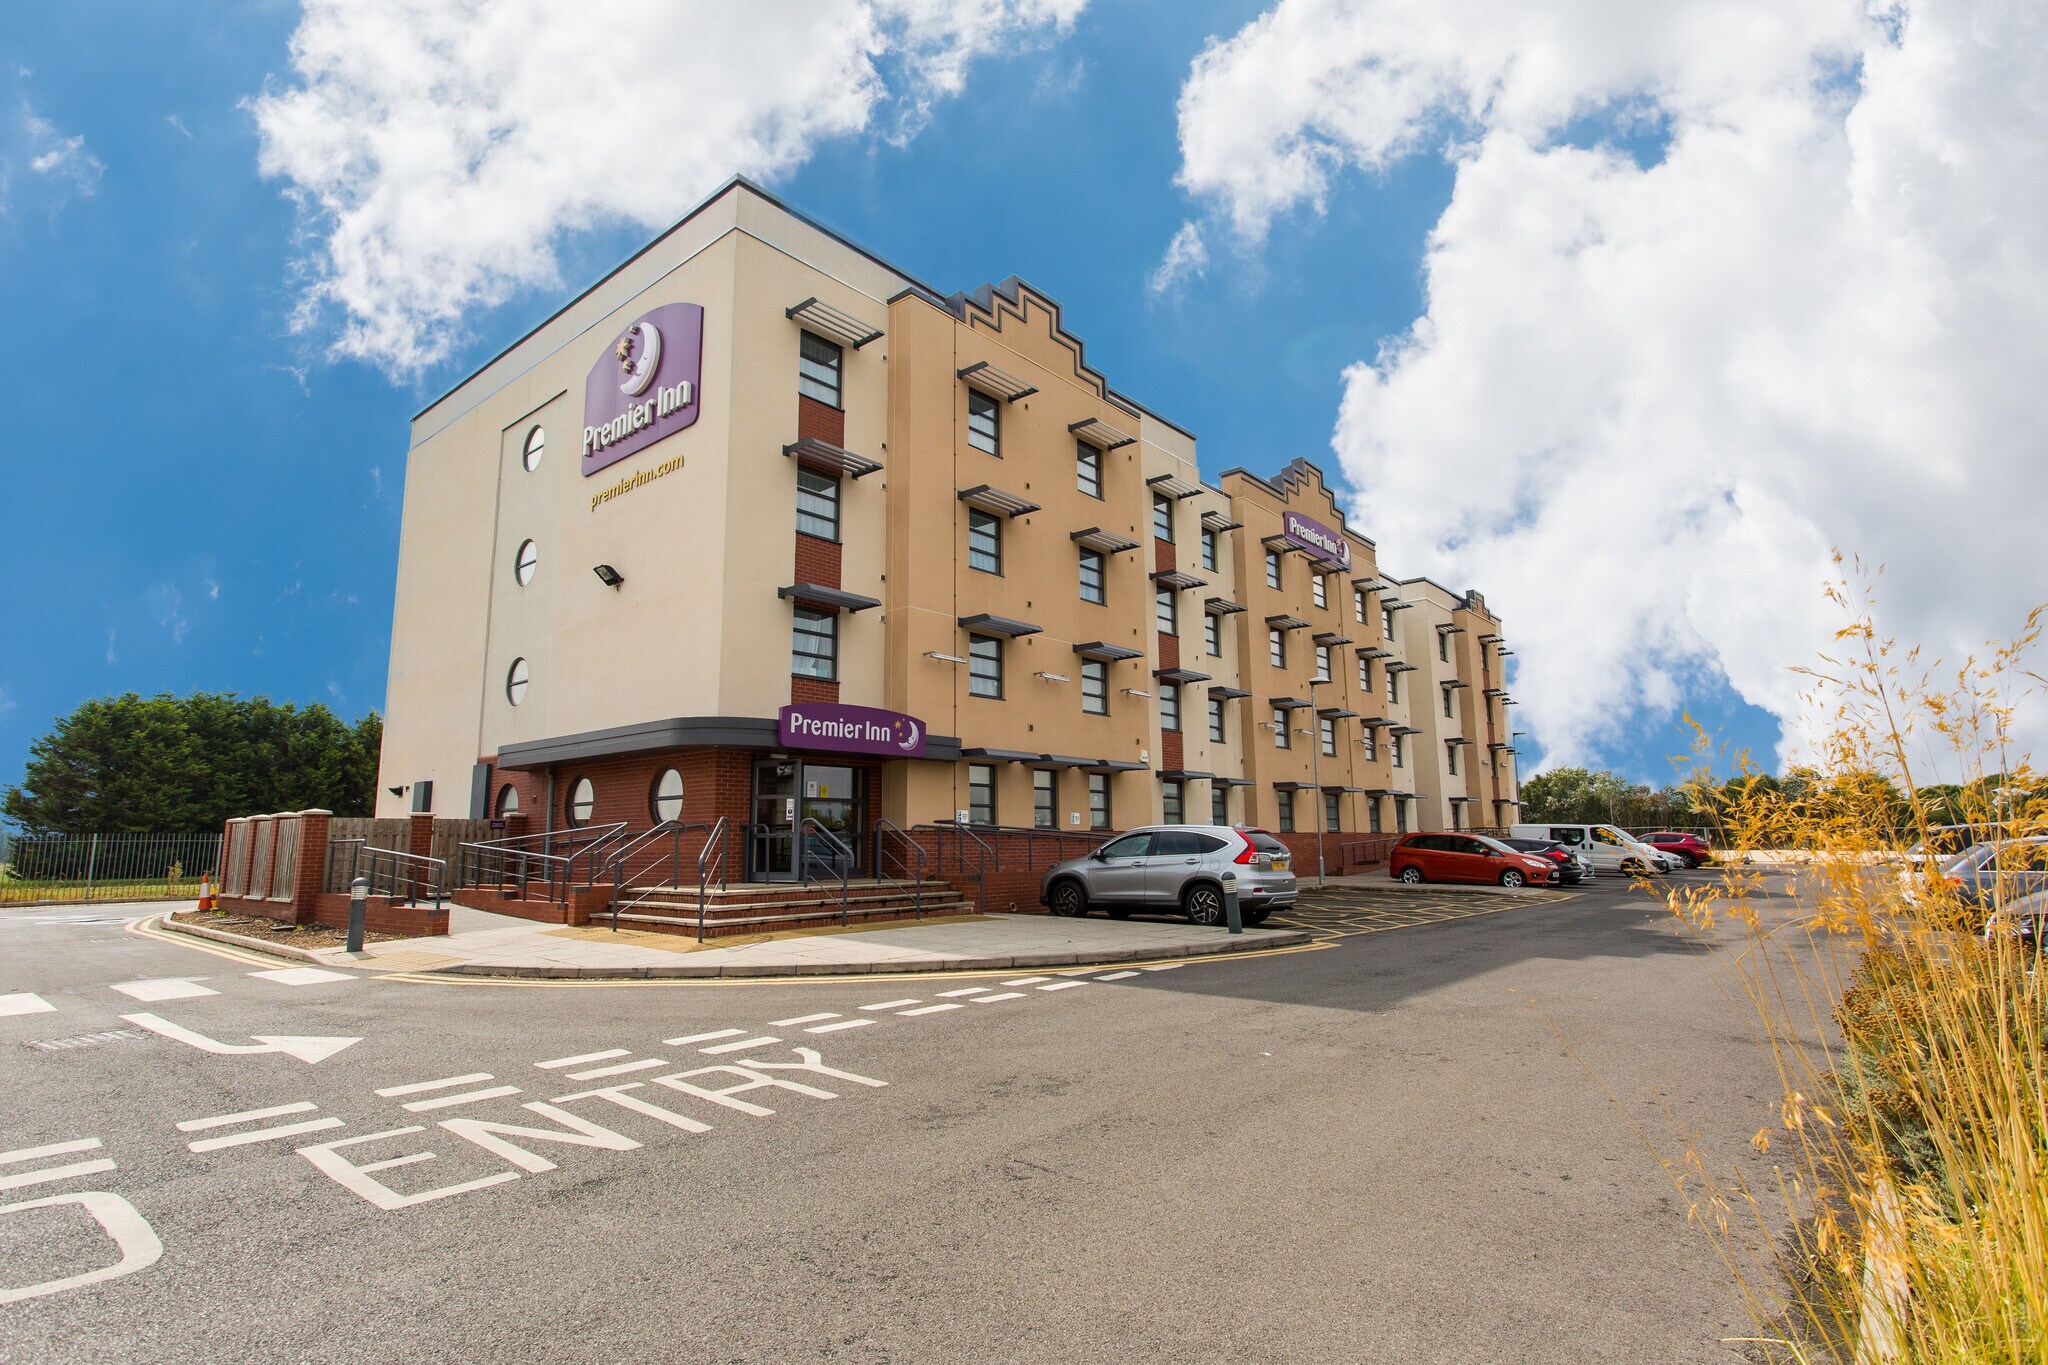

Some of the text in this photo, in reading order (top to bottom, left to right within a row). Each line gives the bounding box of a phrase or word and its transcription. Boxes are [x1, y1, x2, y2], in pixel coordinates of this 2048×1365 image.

[583, 380, 692, 456] Premier Inn
[591, 455, 684, 512] premierinn.com
[1289, 517, 1337, 554] Premier Inn
[790, 712, 891, 742] Premier Inn
[295, 1047, 888, 1210] ENTRY
